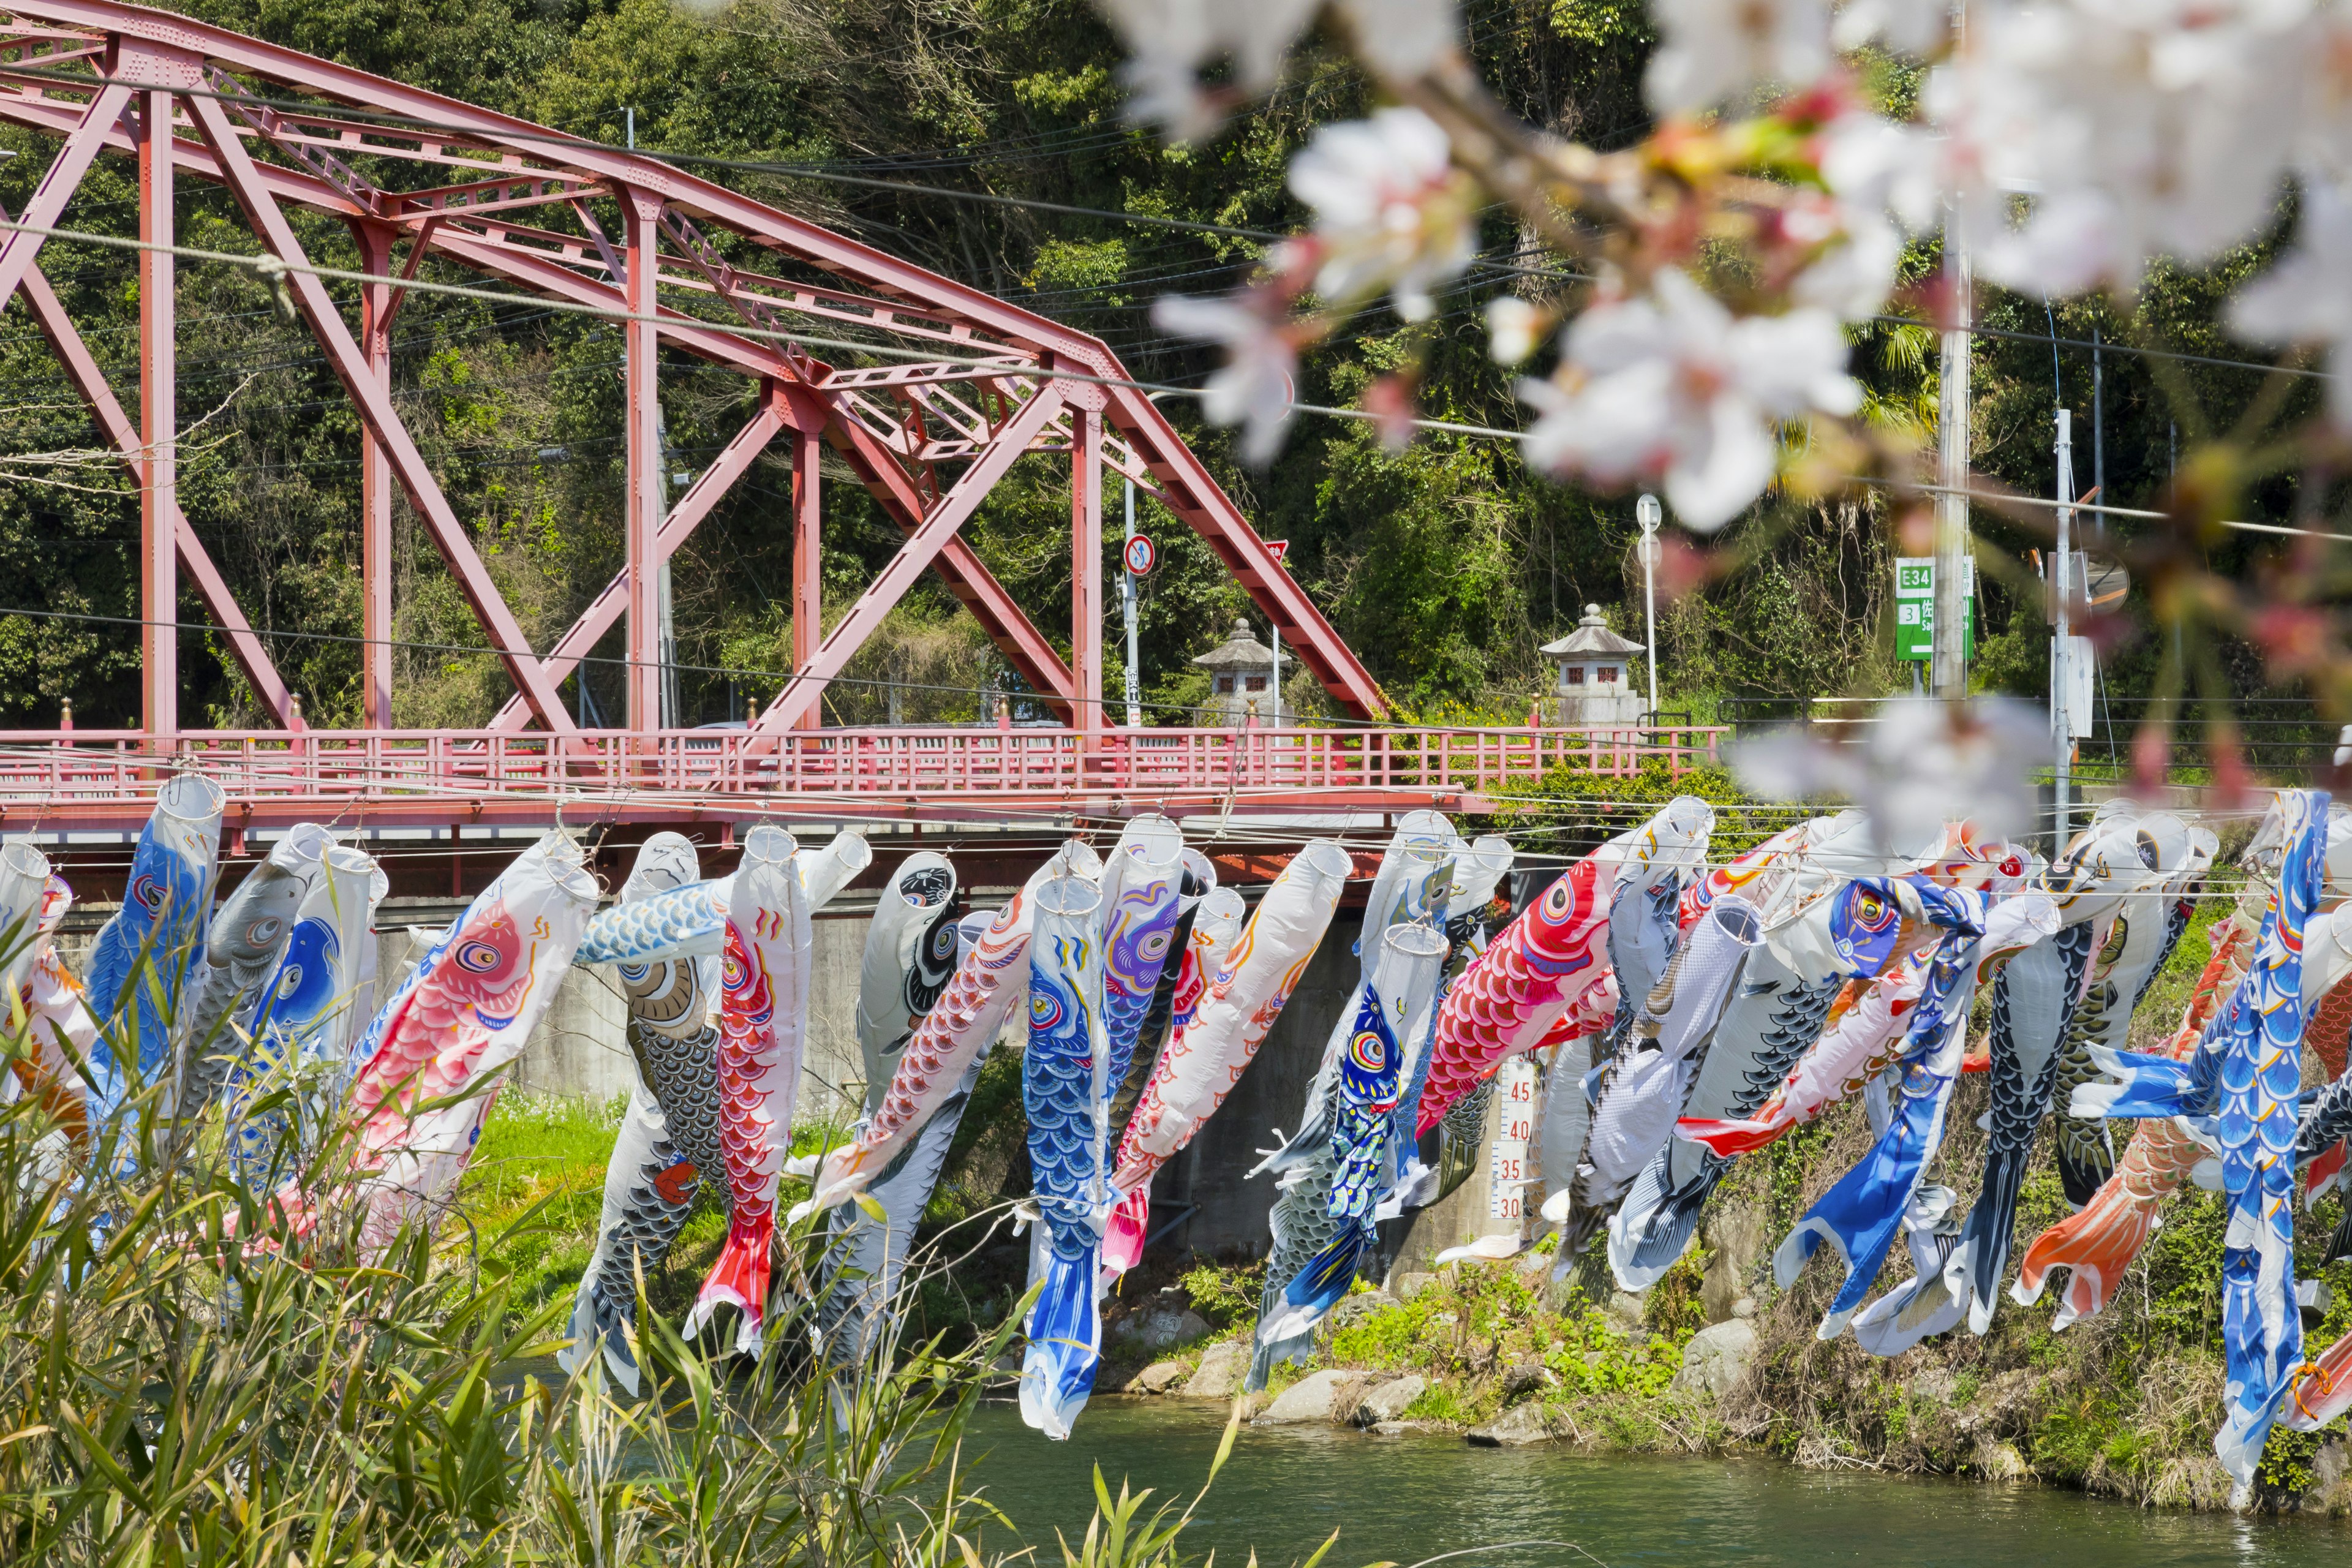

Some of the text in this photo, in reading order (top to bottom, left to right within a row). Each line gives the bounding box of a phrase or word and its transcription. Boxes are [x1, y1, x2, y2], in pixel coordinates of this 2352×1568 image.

[1269, 546, 1281, 557] まれ
[1902, 570, 1929, 586] E34
[1905, 607, 1913, 621] 3
